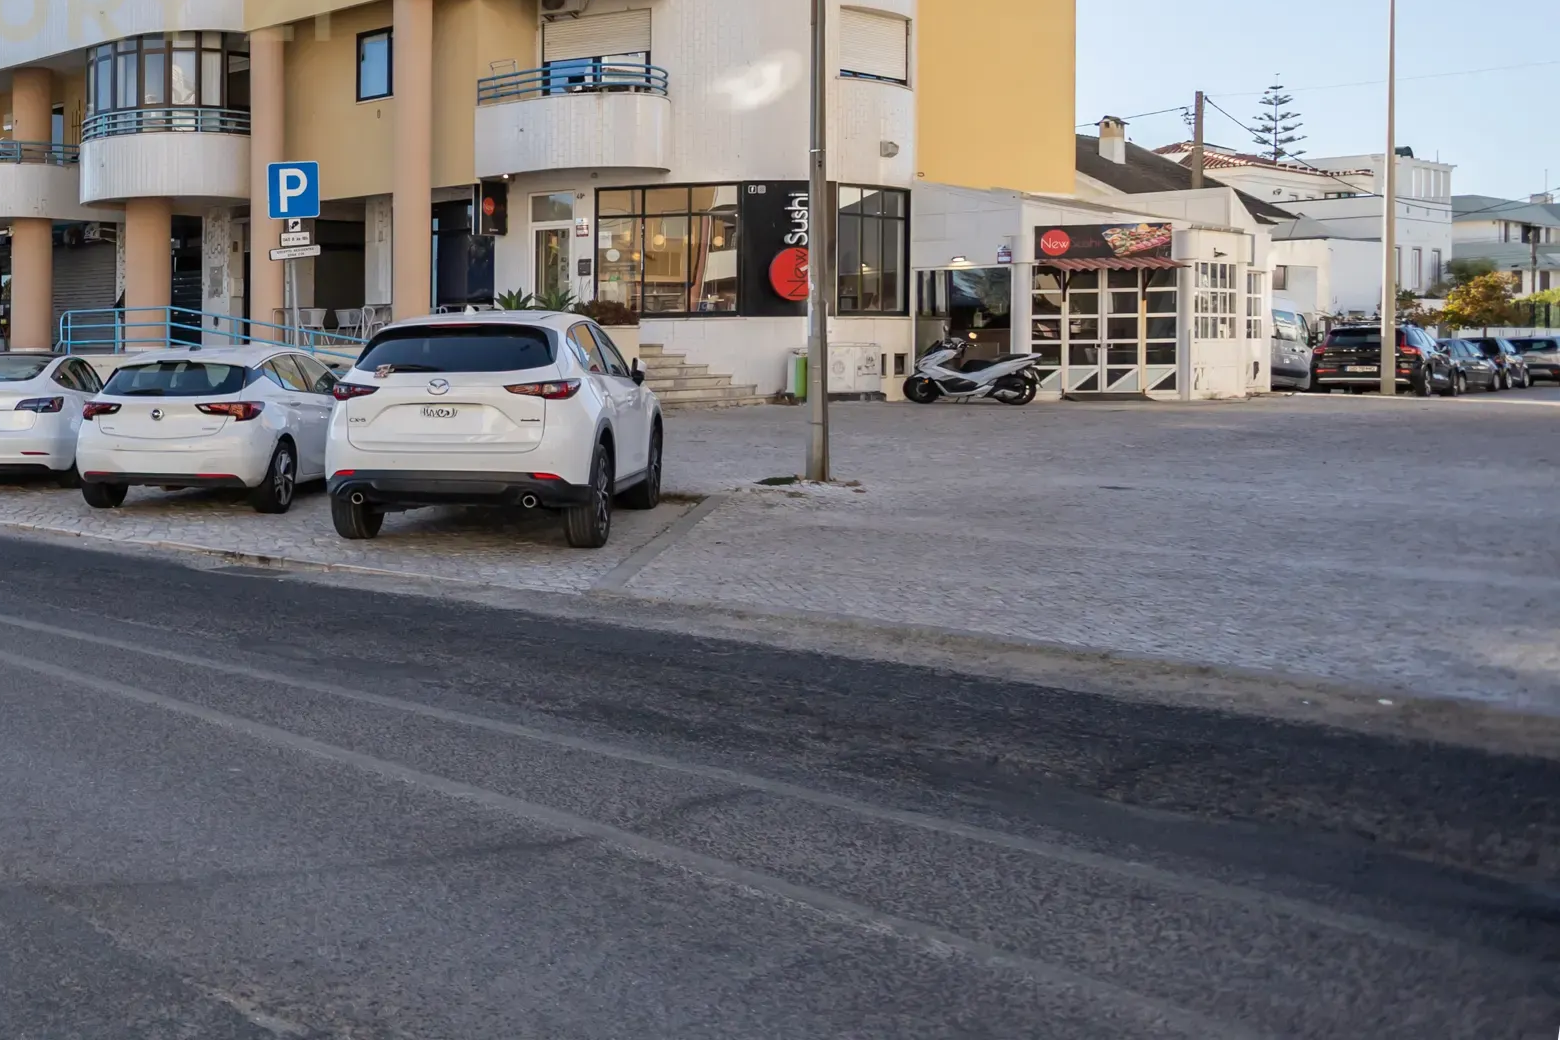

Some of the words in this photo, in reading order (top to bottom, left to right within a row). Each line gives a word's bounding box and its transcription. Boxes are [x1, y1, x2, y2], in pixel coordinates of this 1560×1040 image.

[279, 168, 308, 213] P
[784, 192, 809, 246] Sushi
[1040, 236, 1069, 250] New
[787, 249, 809, 297] New
